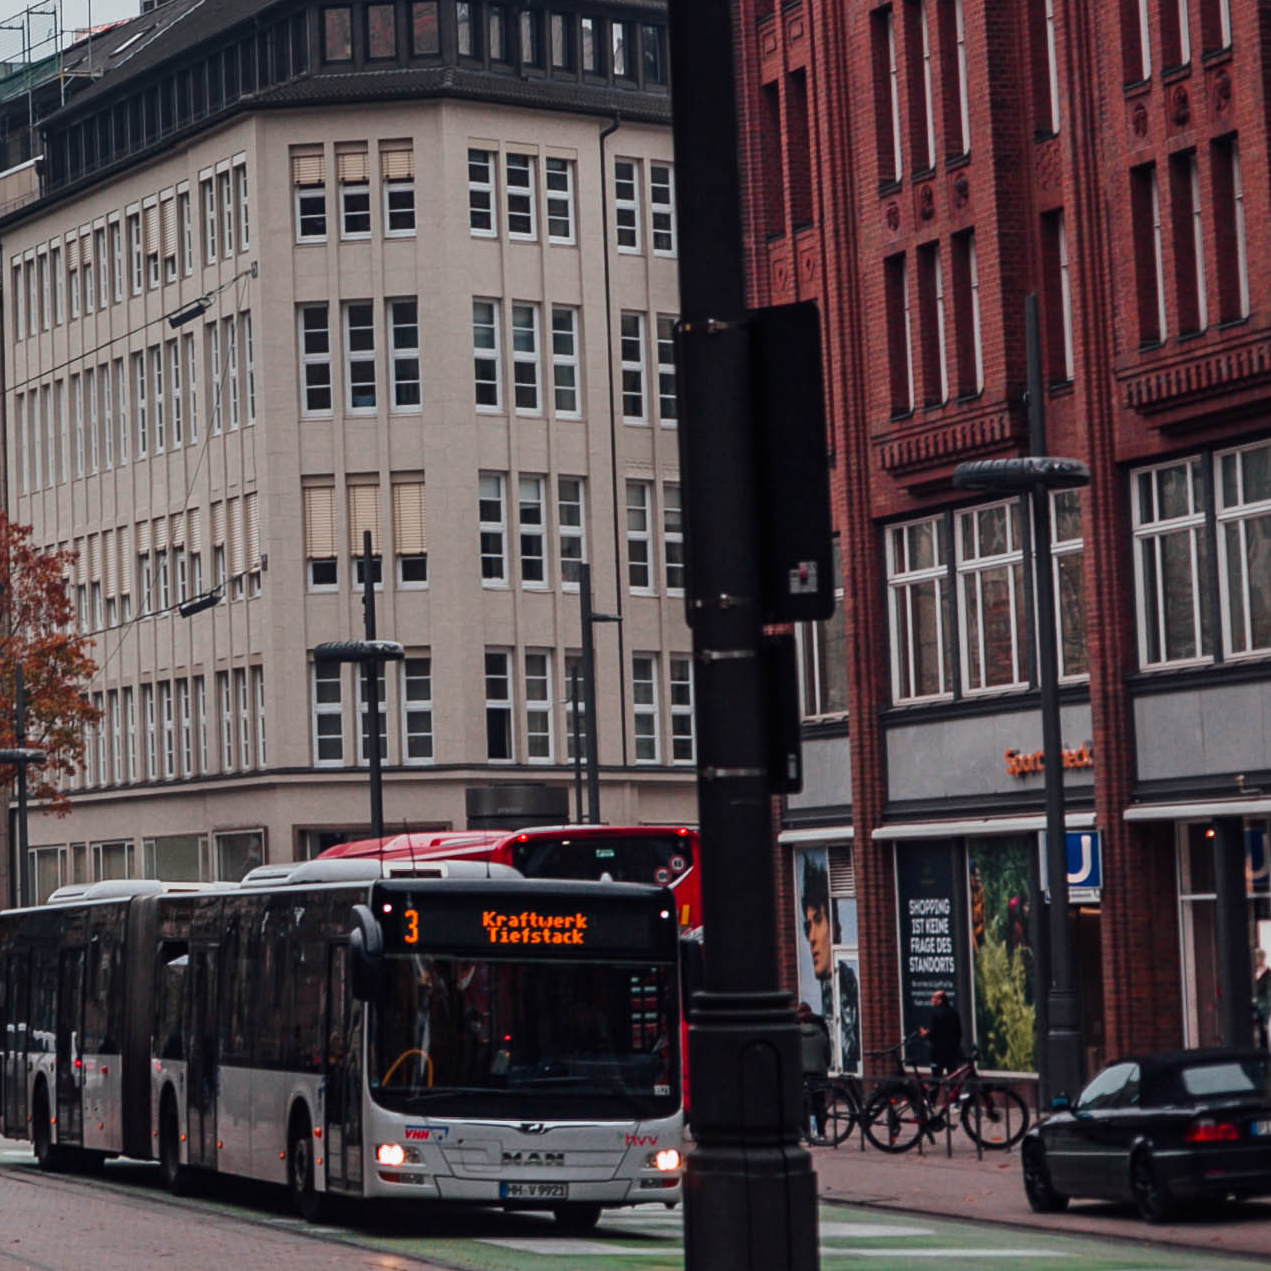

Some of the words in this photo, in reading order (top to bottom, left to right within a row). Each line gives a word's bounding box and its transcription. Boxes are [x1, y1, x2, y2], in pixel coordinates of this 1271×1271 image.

[908, 898, 951, 916] SHOPPING
[404, 909, 419, 944] 3
[482, 911, 588, 929] Kraftwerk
[911, 918, 925, 935] IST
[925, 918, 950, 935] KEINE
[487, 928, 585, 945] Tiefstack
[910, 937, 935, 954] FRAGE
[936, 937, 952, 954] DES
[909, 956, 955, 974] STANDORTS
[404, 1129, 430, 1140] VHH
[625, 1132, 660, 1147] hvv
[501, 1152, 565, 1167] MAN
